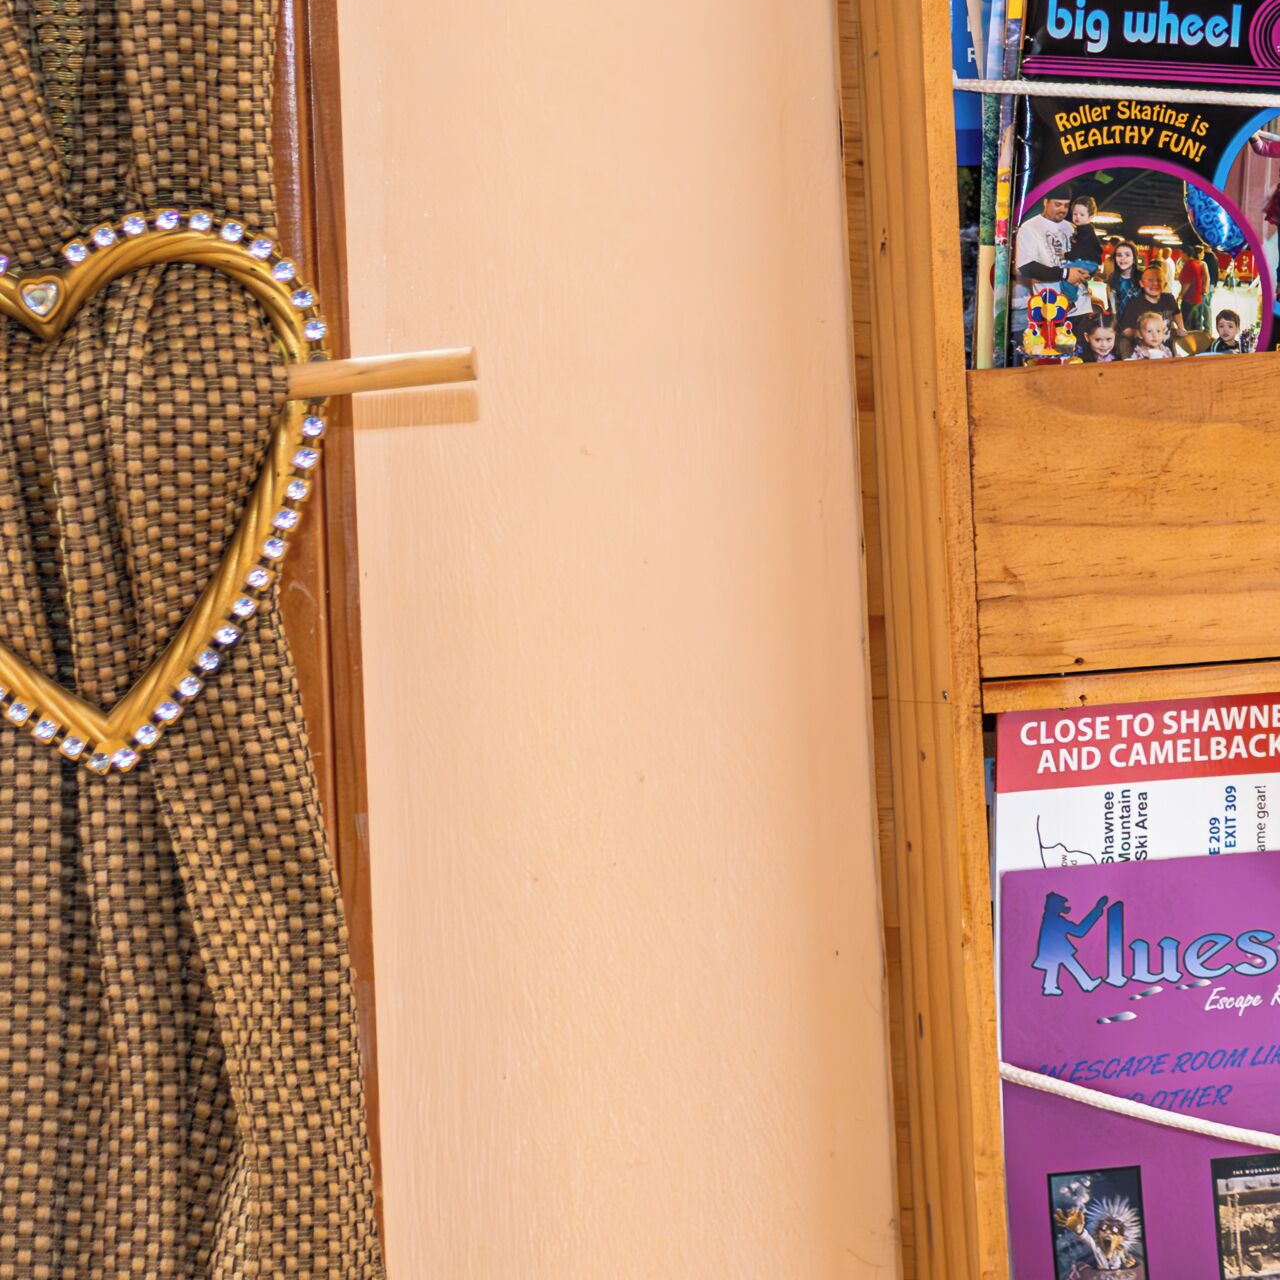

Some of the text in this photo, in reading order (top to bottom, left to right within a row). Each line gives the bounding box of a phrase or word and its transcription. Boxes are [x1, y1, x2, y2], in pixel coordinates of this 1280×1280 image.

[1123, 0, 1243, 48] wheel
[1054, 100, 1210, 137] Roller Skating is
[1060, 125, 1207, 163] HEALTHY FUN!
[1205, 987, 1263, 1016] Escape
